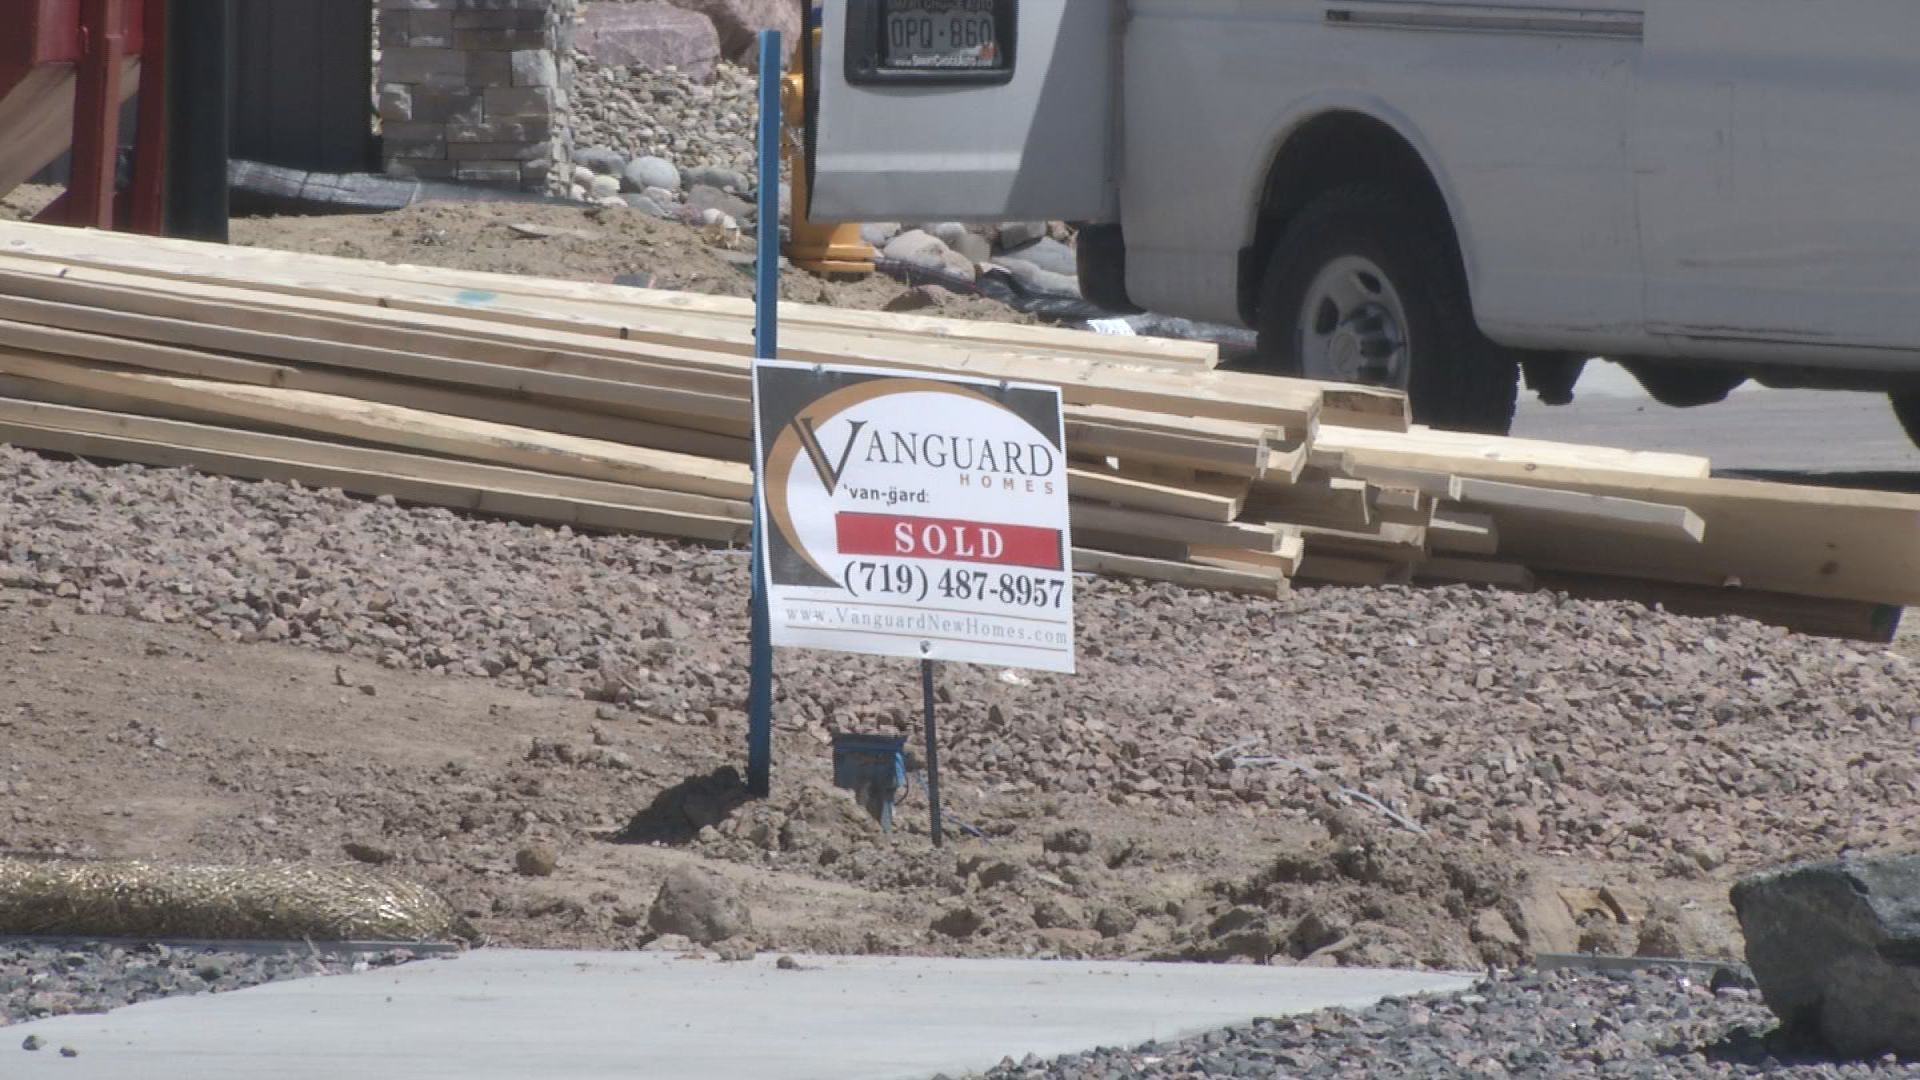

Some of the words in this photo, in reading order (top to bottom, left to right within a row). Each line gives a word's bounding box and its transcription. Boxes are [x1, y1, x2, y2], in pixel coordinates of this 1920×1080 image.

[791, 416, 1054, 498] VANGUARD
[960, 473, 1054, 495] HOMES
[894, 521, 1004, 559] SOLD
[844, 560, 929, 601] (719)
[937, 569, 1065, 609] 487-8957
[784, 606, 1068, 645] www.VanguardNewHomes.com
